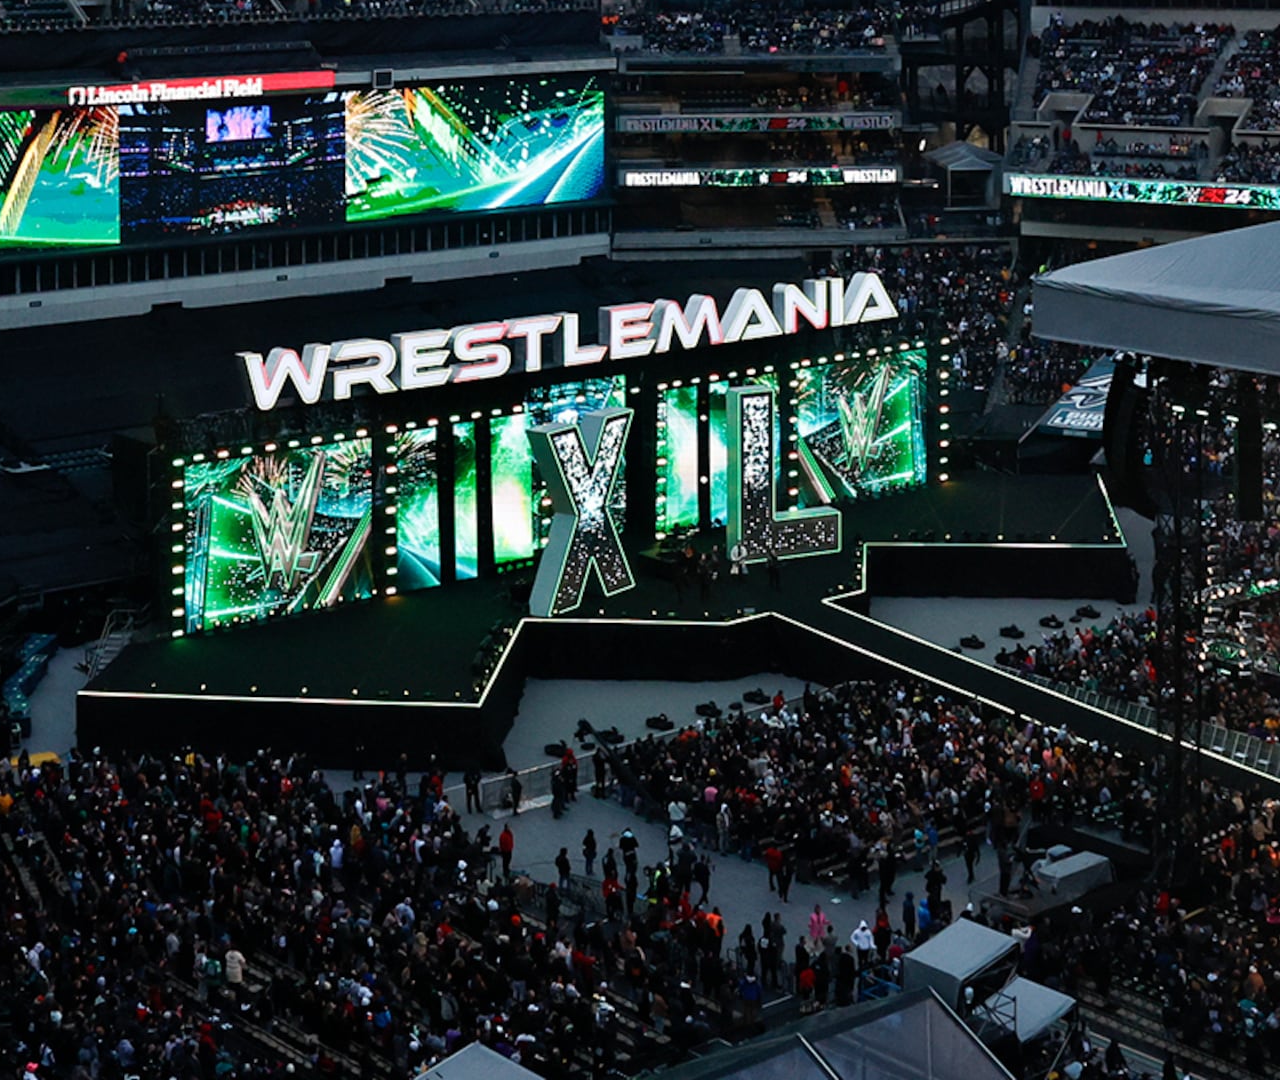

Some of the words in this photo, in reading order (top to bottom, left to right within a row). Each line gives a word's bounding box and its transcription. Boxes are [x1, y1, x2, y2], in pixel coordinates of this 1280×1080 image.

[87, 83, 148, 105] Lincoln
[150, 80, 222, 103] Financial
[224, 77, 263, 97] Field
[1010, 176, 1107, 198] WRESTLEMANIA
[235, 271, 899, 411] WRESTLEMANIA
